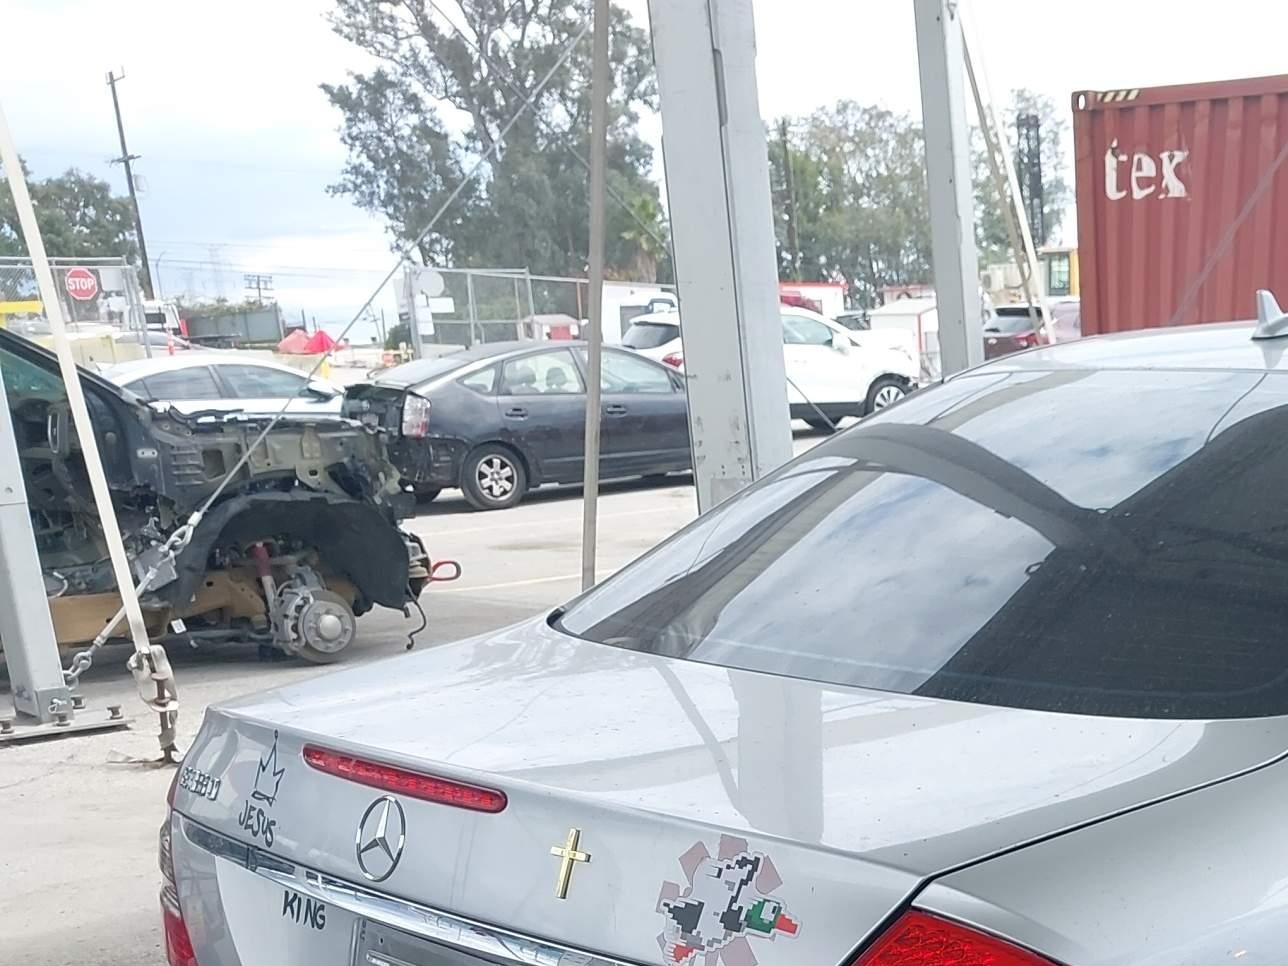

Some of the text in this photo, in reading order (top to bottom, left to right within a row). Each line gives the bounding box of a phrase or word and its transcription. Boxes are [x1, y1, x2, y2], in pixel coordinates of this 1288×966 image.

[1104, 137, 1189, 201] tex
[68, 277, 95, 290] STOP
[238, 799, 277, 849] JESUS
[282, 890, 326, 930] KING
